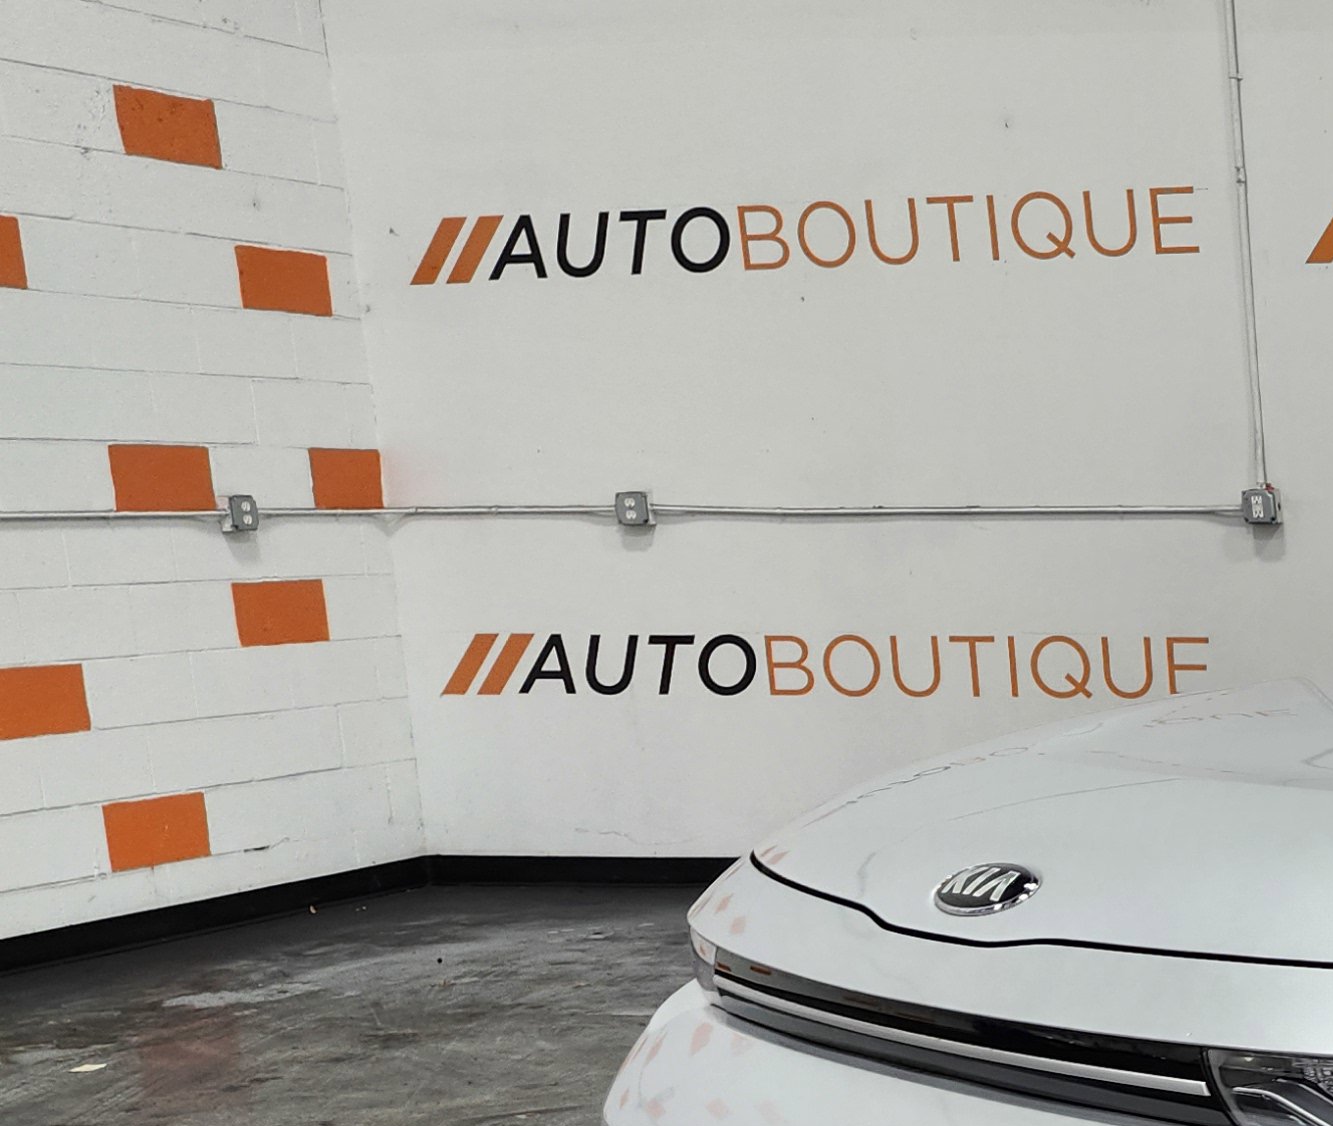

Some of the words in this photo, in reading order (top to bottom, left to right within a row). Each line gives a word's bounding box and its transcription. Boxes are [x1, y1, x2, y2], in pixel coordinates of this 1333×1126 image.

[488, 185, 1202, 281] AUTOBOUTIQUE
[518, 632, 1211, 700] AUTOBOUTIQUE
[941, 866, 1022, 902] KIA
